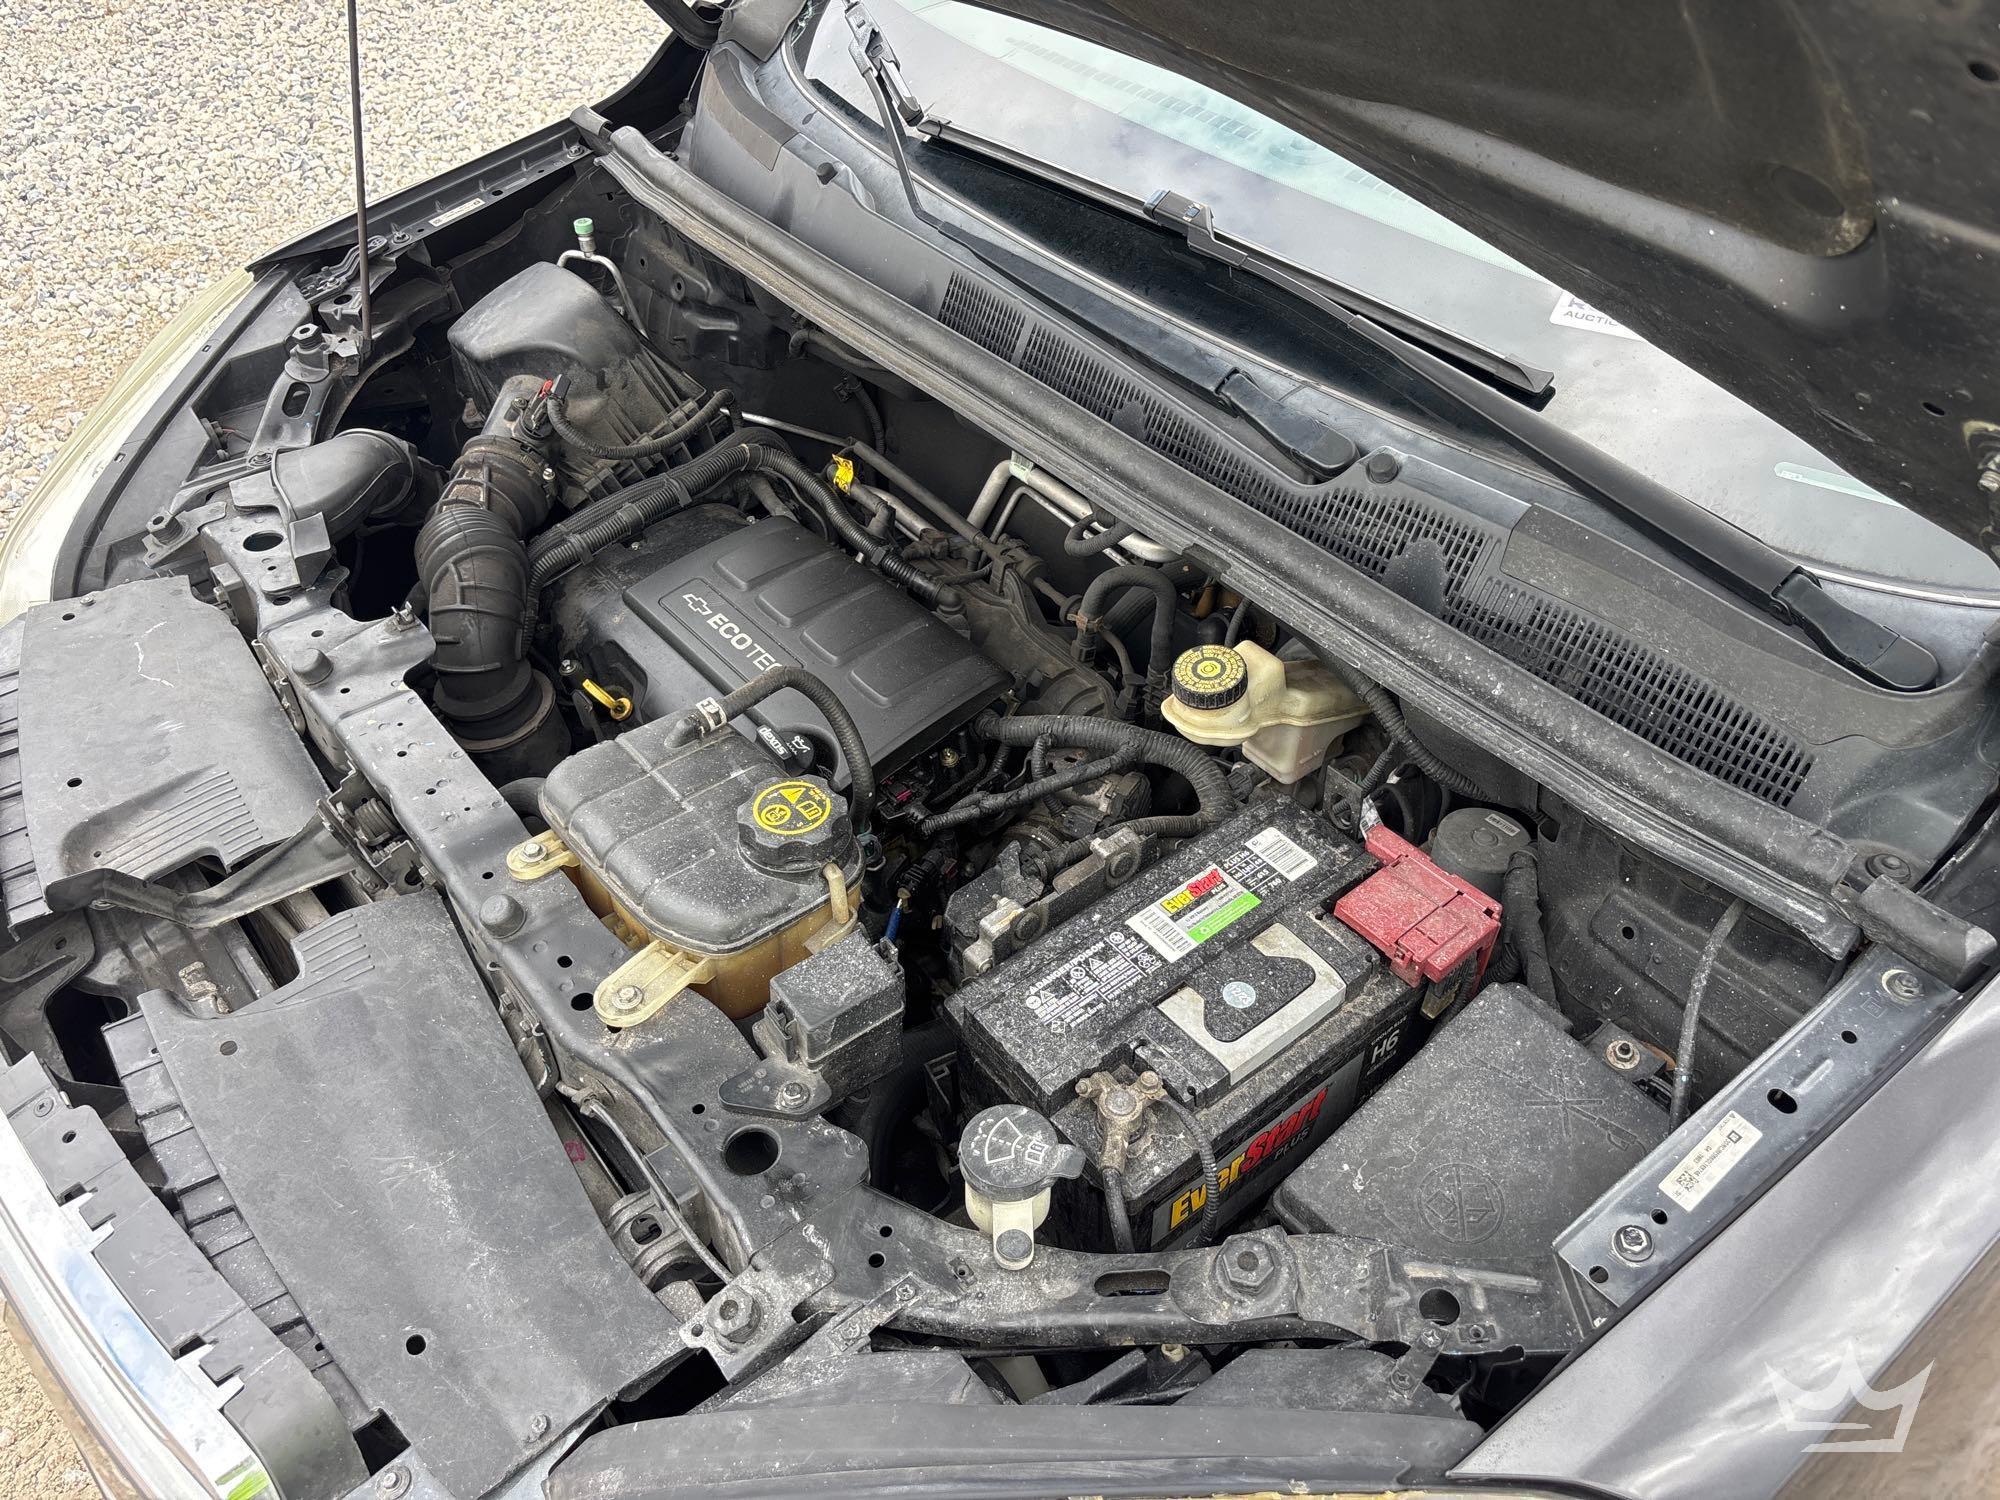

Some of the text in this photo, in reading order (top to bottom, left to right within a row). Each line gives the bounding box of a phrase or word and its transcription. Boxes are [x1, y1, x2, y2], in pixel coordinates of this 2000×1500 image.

[759, 727, 788, 755] dexos
[1161, 868, 1225, 914] EverStart
[1370, 1029, 1400, 1065] H6
[1170, 1087, 1329, 1231] EverStart
[1274, 1127, 1311, 1161] PLUS
